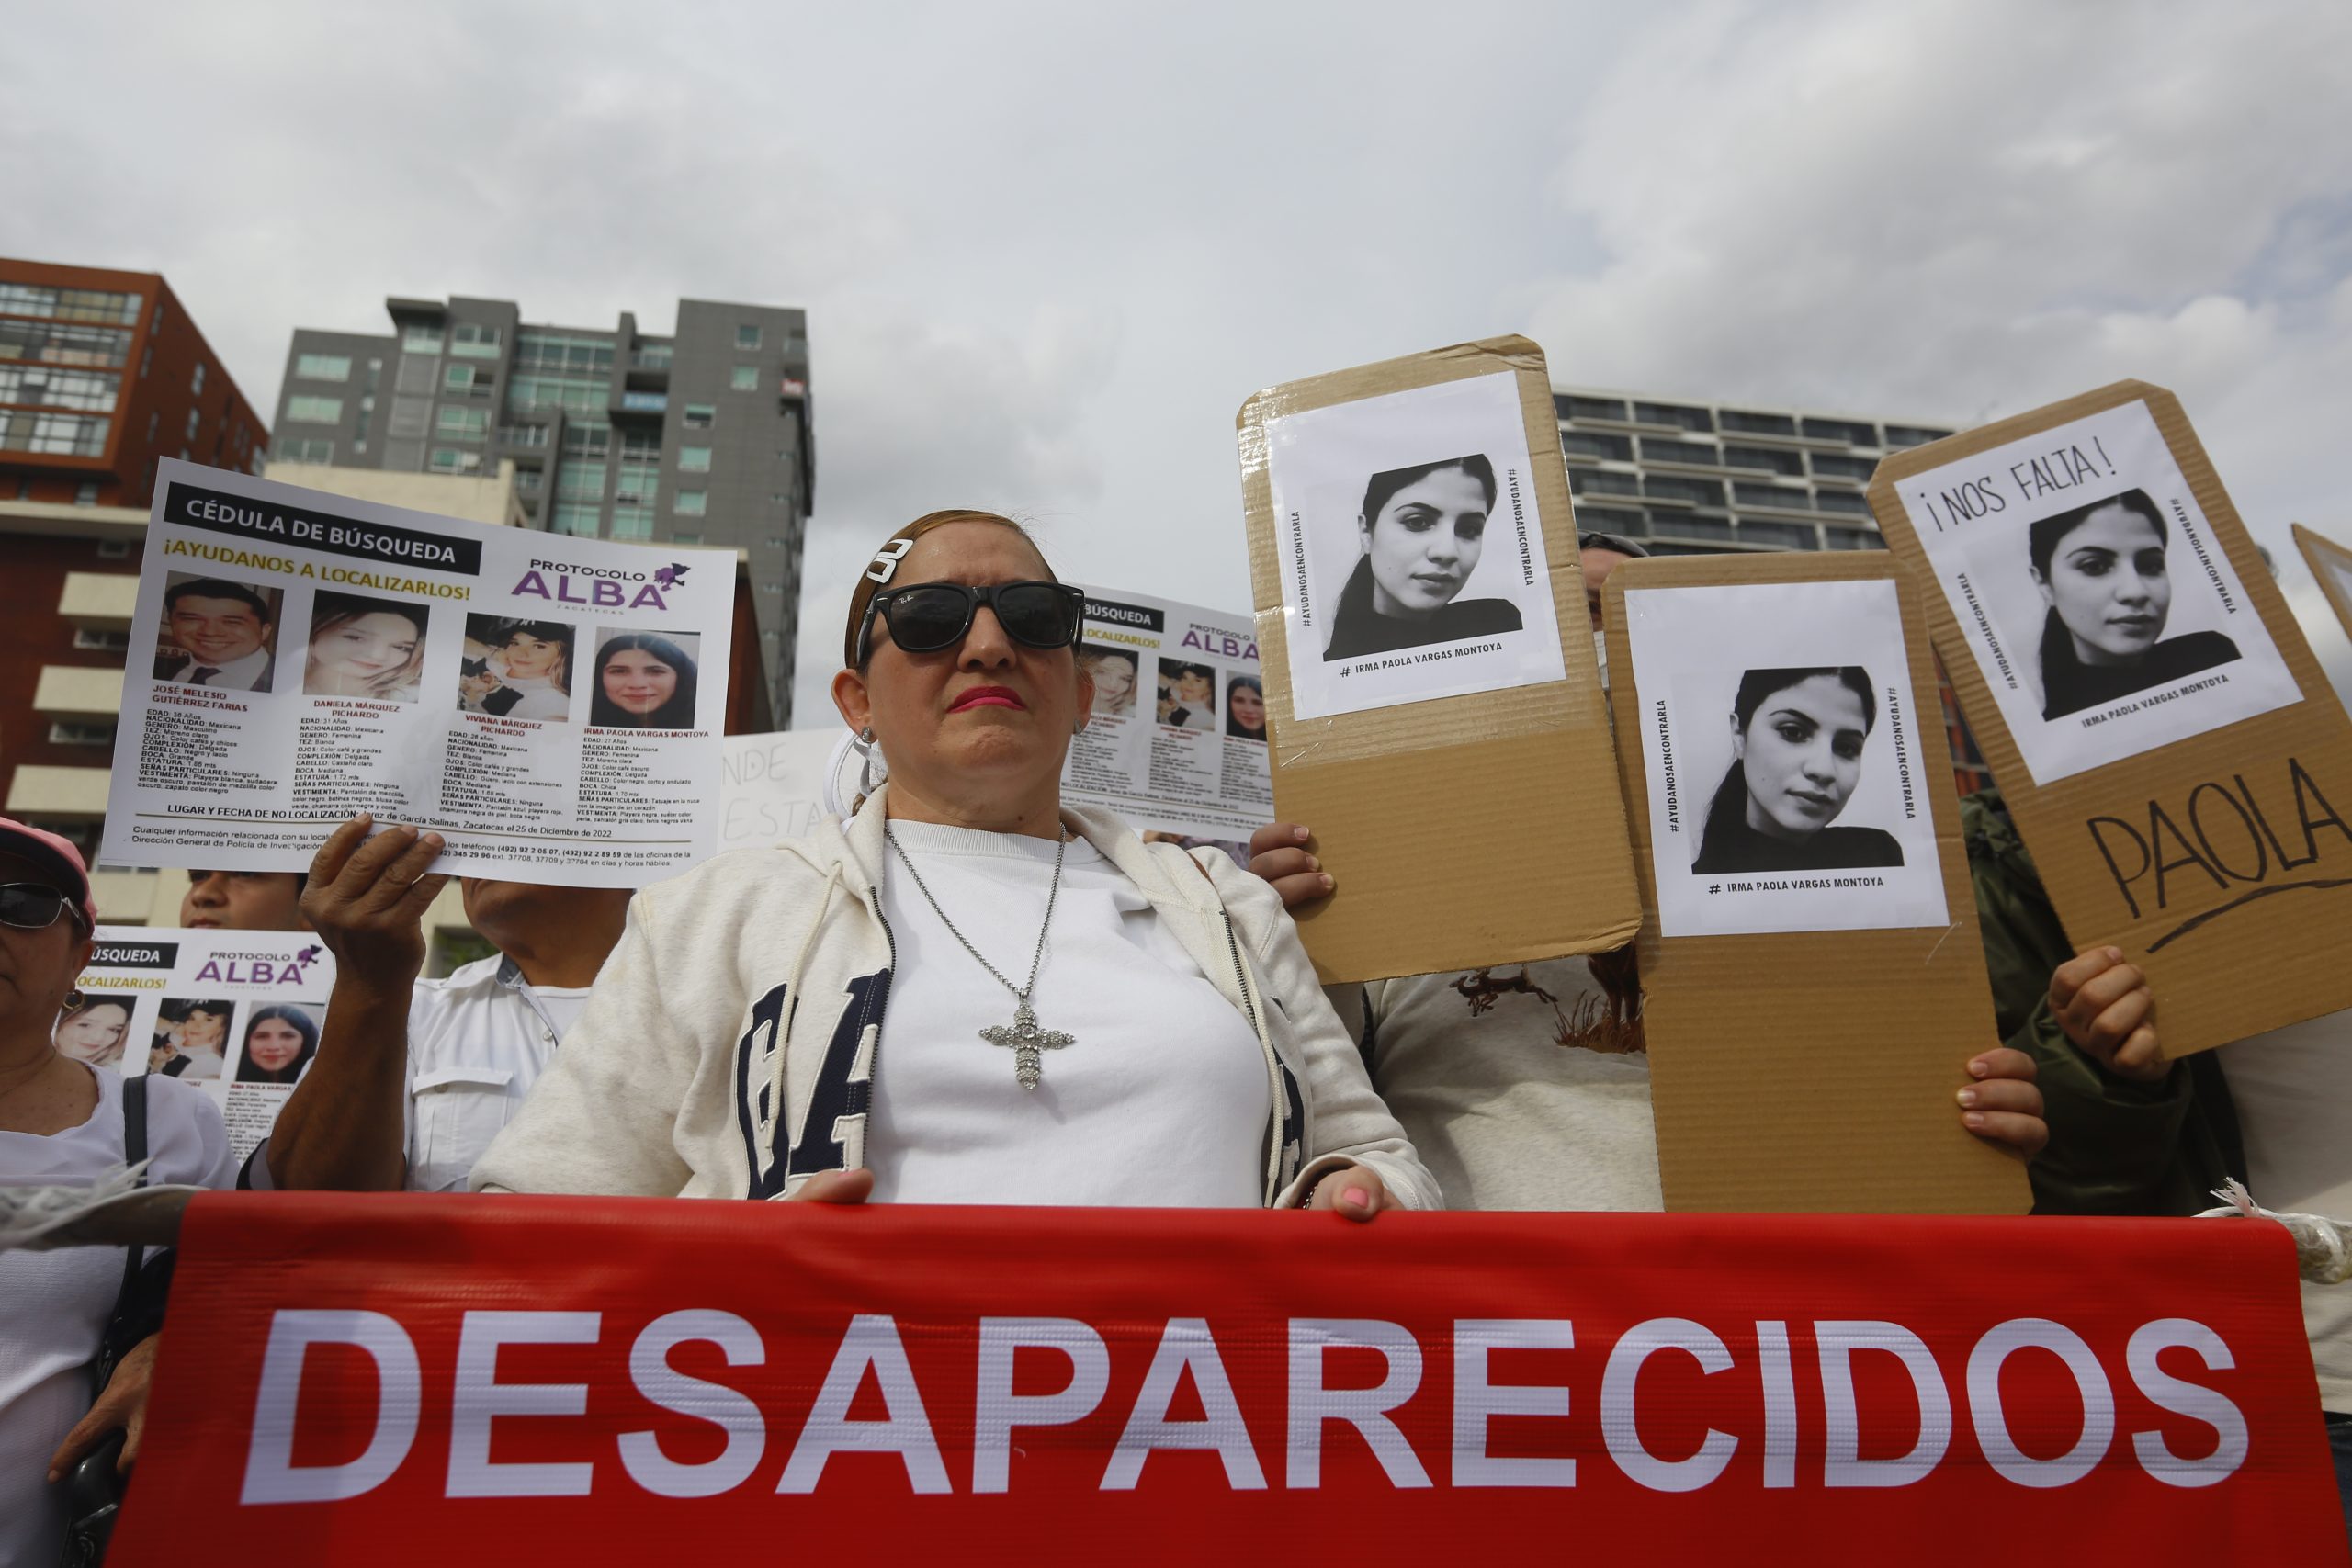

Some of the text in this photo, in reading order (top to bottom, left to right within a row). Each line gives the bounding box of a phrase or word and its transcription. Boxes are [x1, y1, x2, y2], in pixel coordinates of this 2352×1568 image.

[2009, 436, 2117, 502] FALTA!
[187, 500, 456, 563] CÉDULA DE BÚSQUEDA
[1508, 468, 1534, 586] #AYUDANOSAENCONTRARLA
[2169, 498, 2237, 615] #AYUDANOSAENCONTRARLA
[164, 539, 470, 601] ¡AYUDANOS A LOCALIZARLOS!
[530, 558, 646, 581] PROTOCOLO
[1292, 512, 1311, 626] #AYUDANOSAENCONTRARLA
[512, 570, 667, 610] ALBA
[1085, 603, 1151, 625] BÚSQUEDA
[1190, 623, 1250, 641] PROTOCOLO
[1958, 573, 2018, 689] #AYUDANOSAENCONTRARLA
[1182, 630, 1259, 661] ALBA
[1340, 642, 1503, 677] # IRMA PAOLA VARGAS MONTOYA
[153, 685, 227, 700] JOSÉ MELESIO
[153, 694, 248, 712] GUTIÉRREZ FARIAS
[2082, 674, 2229, 728] IRMA PAOLA VARGAS MONTOYA
[314, 700, 400, 713] DANIELA MÁRQUEZ
[332, 709, 379, 719] PICHARDO
[466, 715, 542, 729] VIVIANA MÁRQUEZ
[481, 726, 525, 737] PICHARDO
[1888, 687, 1915, 819] #AYUDANOSAENCONTRARLA
[1657, 700, 1679, 832] #AYUDANOSAENCONTRARLA
[133, 826, 175, 836] Cualquier
[178, 828, 229, 839] información
[232, 831, 279, 840] relacionada
[167, 805, 205, 815] LUGAR
[208, 807, 215, 815] Y
[218, 807, 252, 817] FECHA
[255, 809, 268, 818] DE
[272, 810, 286, 818] NO
[288, 809, 359, 819] LOCALIZACIÓN:
[400, 814, 426, 824] García
[429, 816, 461, 828] Salinas,
[463, 821, 504, 832] Zacatecas
[507, 824, 514, 832] el
[516, 825, 526, 833] 25
[540, 827, 579, 837] Diciembre
[593, 829, 612, 838] 2022
[132, 836, 173, 845] Dirección
[176, 838, 210, 847] General
[227, 840, 254, 848] Policía
[257, 840, 268, 849] de
[448, 841, 459, 850] los
[461, 842, 496, 852] teléfonos
[497, 845, 517, 853] (492)
[562, 849, 582, 857] (492)
[2086, 757, 2352, 919] PAOLA
[453, 851, 468, 859] 345
[1709, 876, 1884, 895] # IRMA PAOLA VARGAS MONTOYA
[91, 945, 161, 963] ÚSQUEDA
[209, 952, 290, 962] PROTOCOLO
[77, 976, 167, 989] OCALIZARLOS!
[195, 961, 303, 986] ALBA
[240, 1308, 2250, 1506] DESAPARECIDOS
